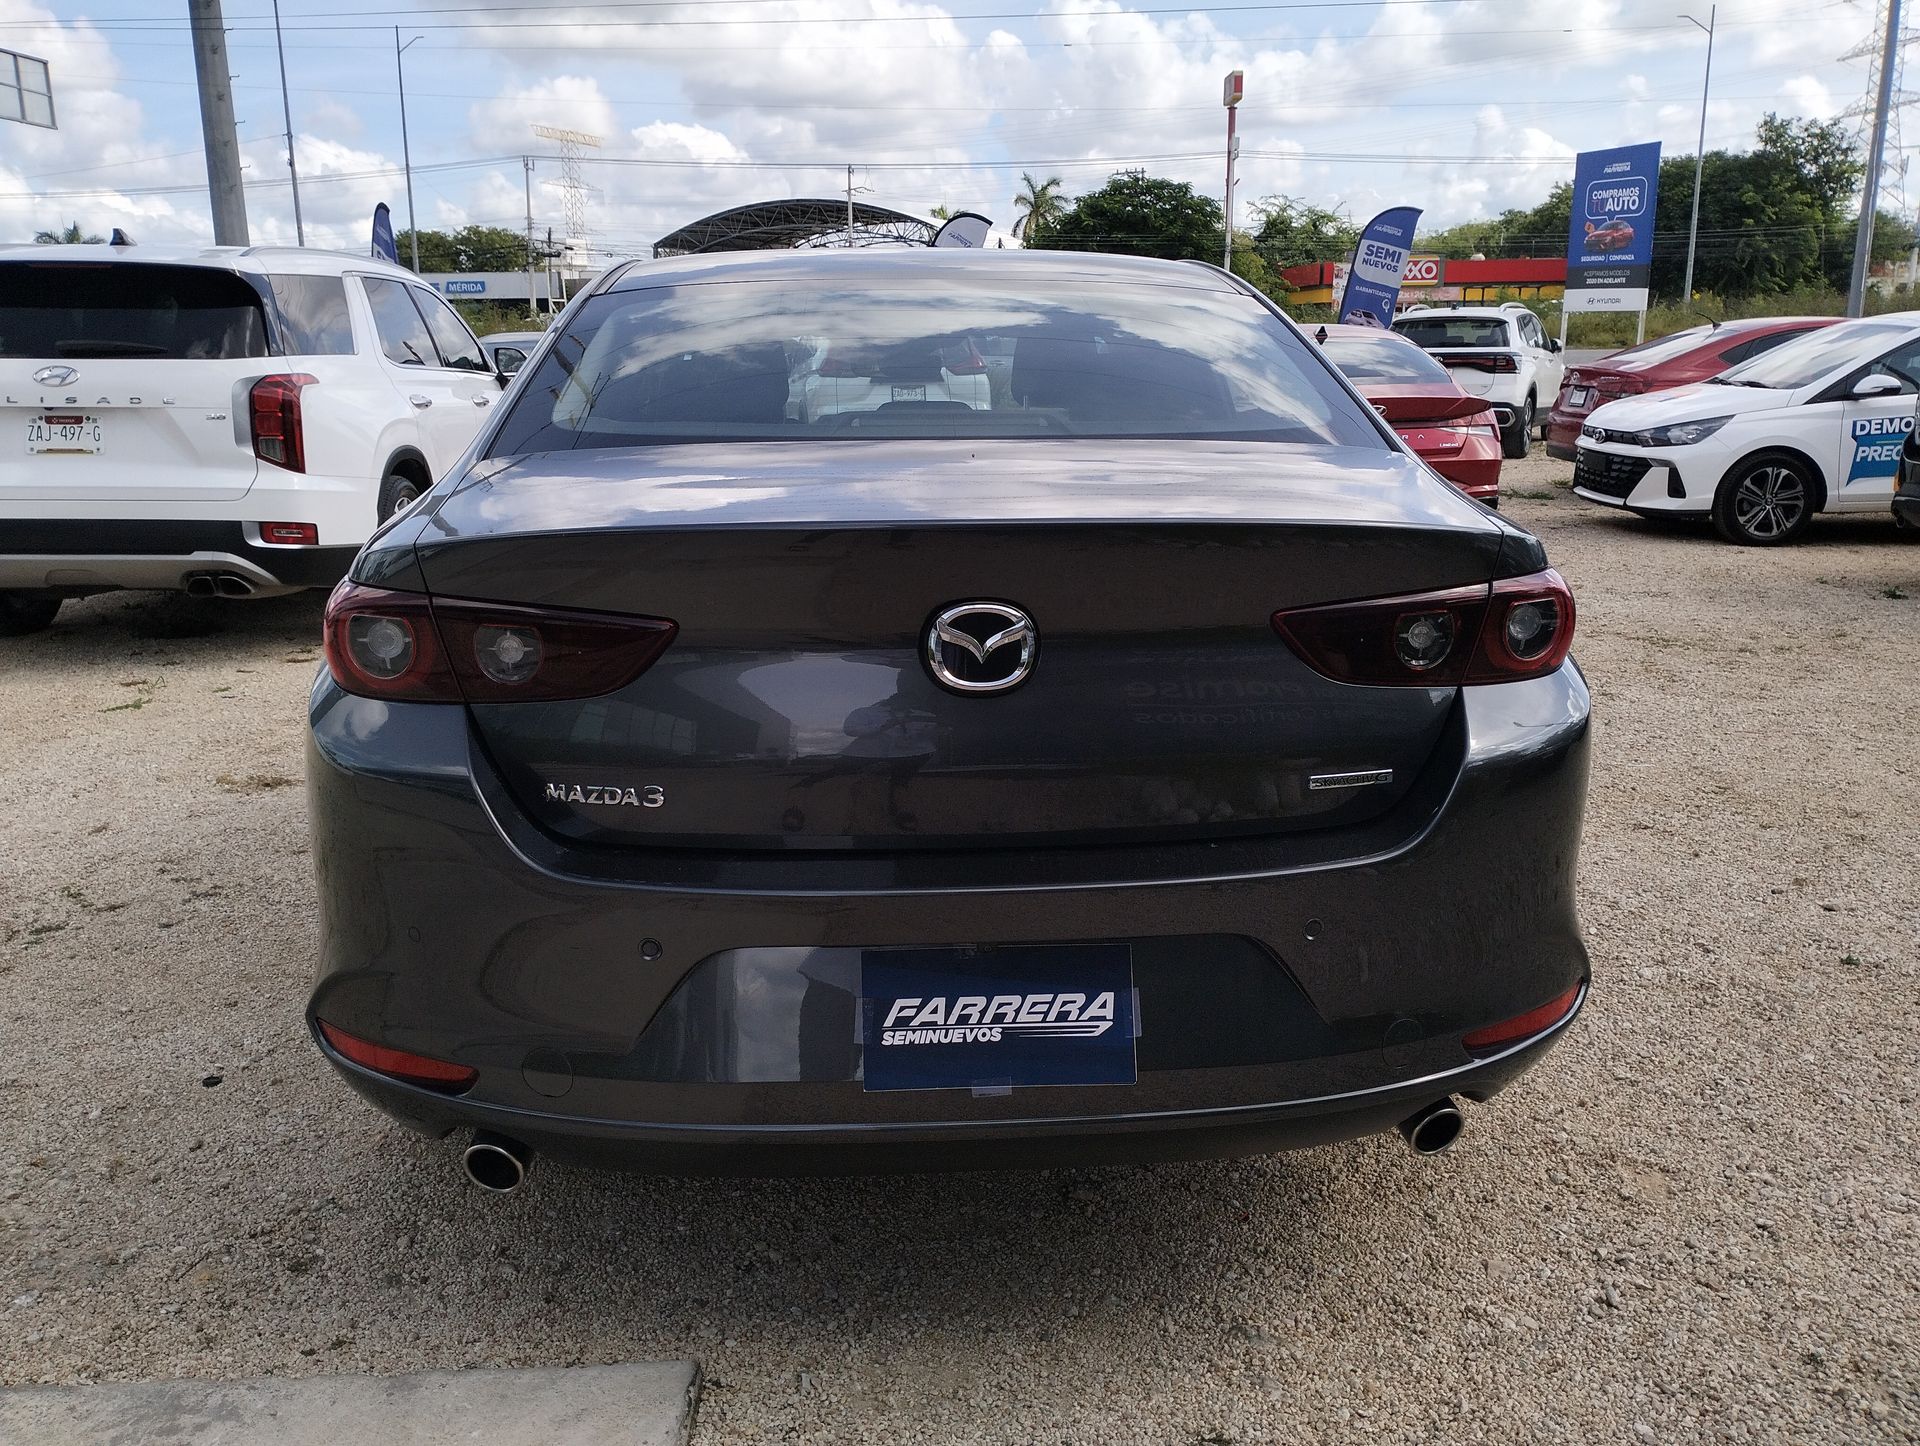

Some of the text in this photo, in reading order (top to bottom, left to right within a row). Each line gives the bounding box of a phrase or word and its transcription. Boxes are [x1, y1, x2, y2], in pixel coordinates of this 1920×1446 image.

[1592, 187, 1640, 200] COMPRAMOS
[1591, 196, 1639, 213] TU AUTO
[1364, 244, 1403, 264] SEMI
[1361, 257, 1399, 273] NUEVOS
[448, 281, 483, 292] MÉRIDA
[1355, 285, 1392, 299] GARANTIZADOS
[27, 424, 101, 442] ZAJ-497-G
[1855, 417, 1915, 436] DEMO
[883, 992, 1115, 1027] FARRERA
[881, 1027, 1003, 1046] SEMINUEVOS
